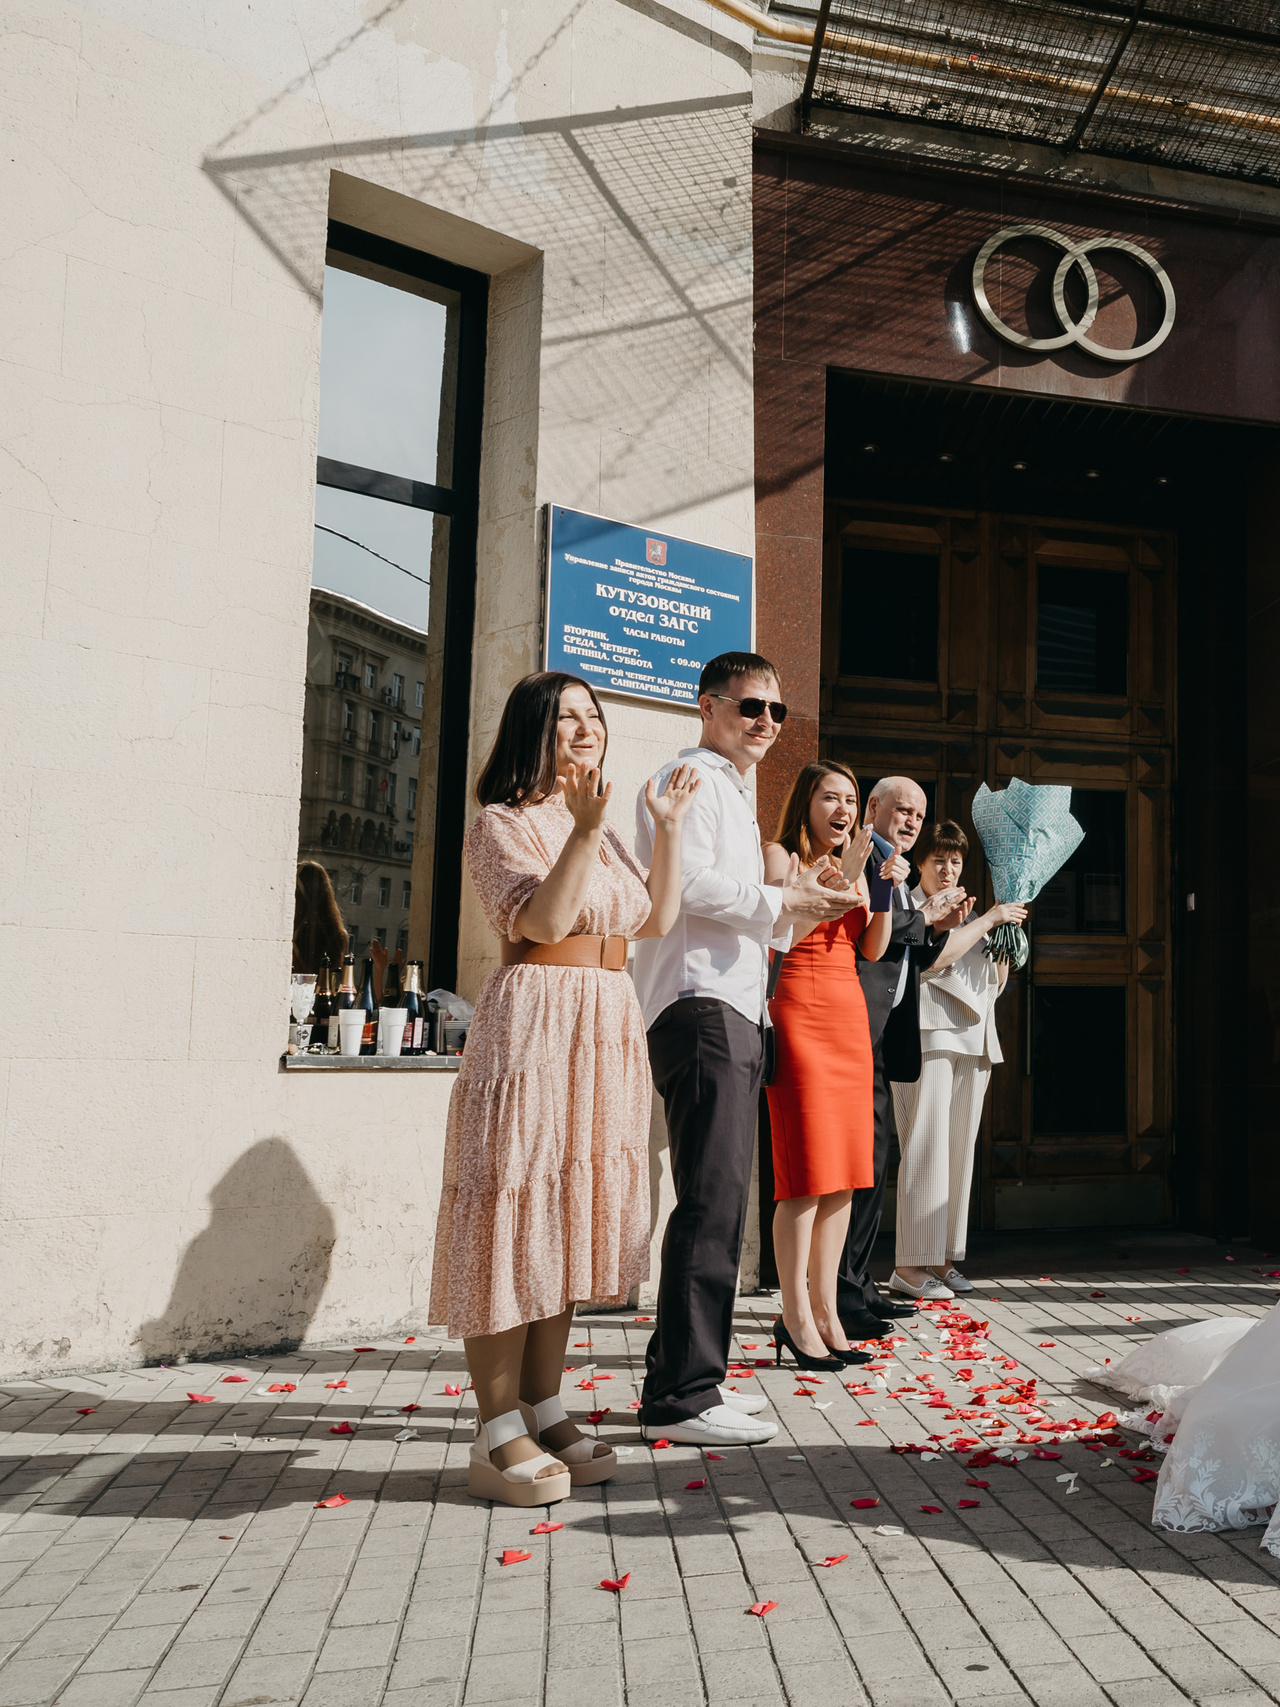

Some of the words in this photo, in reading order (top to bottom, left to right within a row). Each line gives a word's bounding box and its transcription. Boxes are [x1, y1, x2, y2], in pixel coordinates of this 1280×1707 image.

[609, 565, 634, 576] записи
[636, 572, 656, 581] актов
[657, 576, 705, 593] гражданского
[629, 577, 653, 588] города
[654, 581, 682, 594] Москвы
[668, 571, 695, 584] Москвы
[596, 583, 711, 621] КУТУЗОВСКИЙ
[609, 606, 654, 624] отдел
[658, 613, 698, 634] ЗАГС
[563, 624, 609, 642] ВТОРНИК,
[623, 626, 649, 640] ЧАСЫ
[650, 632, 685, 647] РАБОТЫ
[563, 635, 597, 649] СРЕДА,
[600, 641, 641, 658] ЧЕТВЕРГ,
[563, 644, 610, 661] ПЯТНИЦА,
[612, 654, 653, 669] СУББОТА
[677, 657, 701, 669] 09.00
[580, 662, 624, 677] ЧЕТВЕРТЫЙ
[625, 671, 656, 683] ЧЕТВЕРГ
[657, 677, 693, 690] КАЖДОГО
[610, 677, 670, 695] САНИТАРНЫЙ
[671, 688, 695, 699] ДЕНЬ
